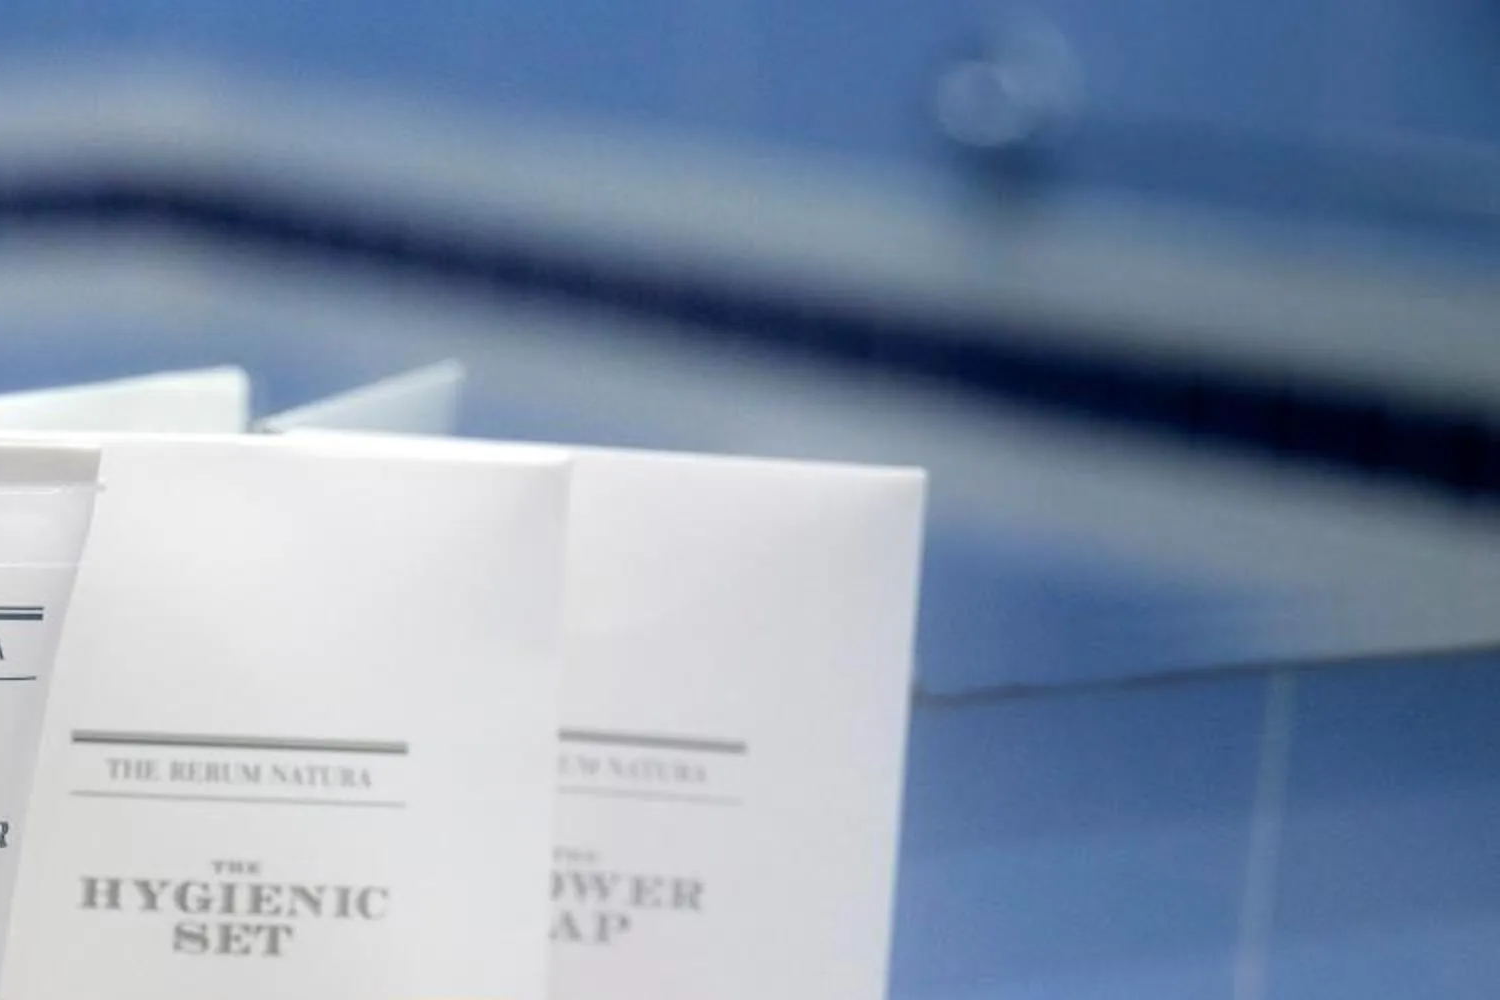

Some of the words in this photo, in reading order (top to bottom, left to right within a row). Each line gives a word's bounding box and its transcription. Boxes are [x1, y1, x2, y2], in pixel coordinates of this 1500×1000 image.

[106, 757, 161, 783] THE
[168, 760, 262, 786] RERUM
[272, 764, 373, 789] NATURA
[211, 859, 263, 876] THE
[78, 874, 392, 921] HYGIENIC
[172, 921, 293, 957] SET
